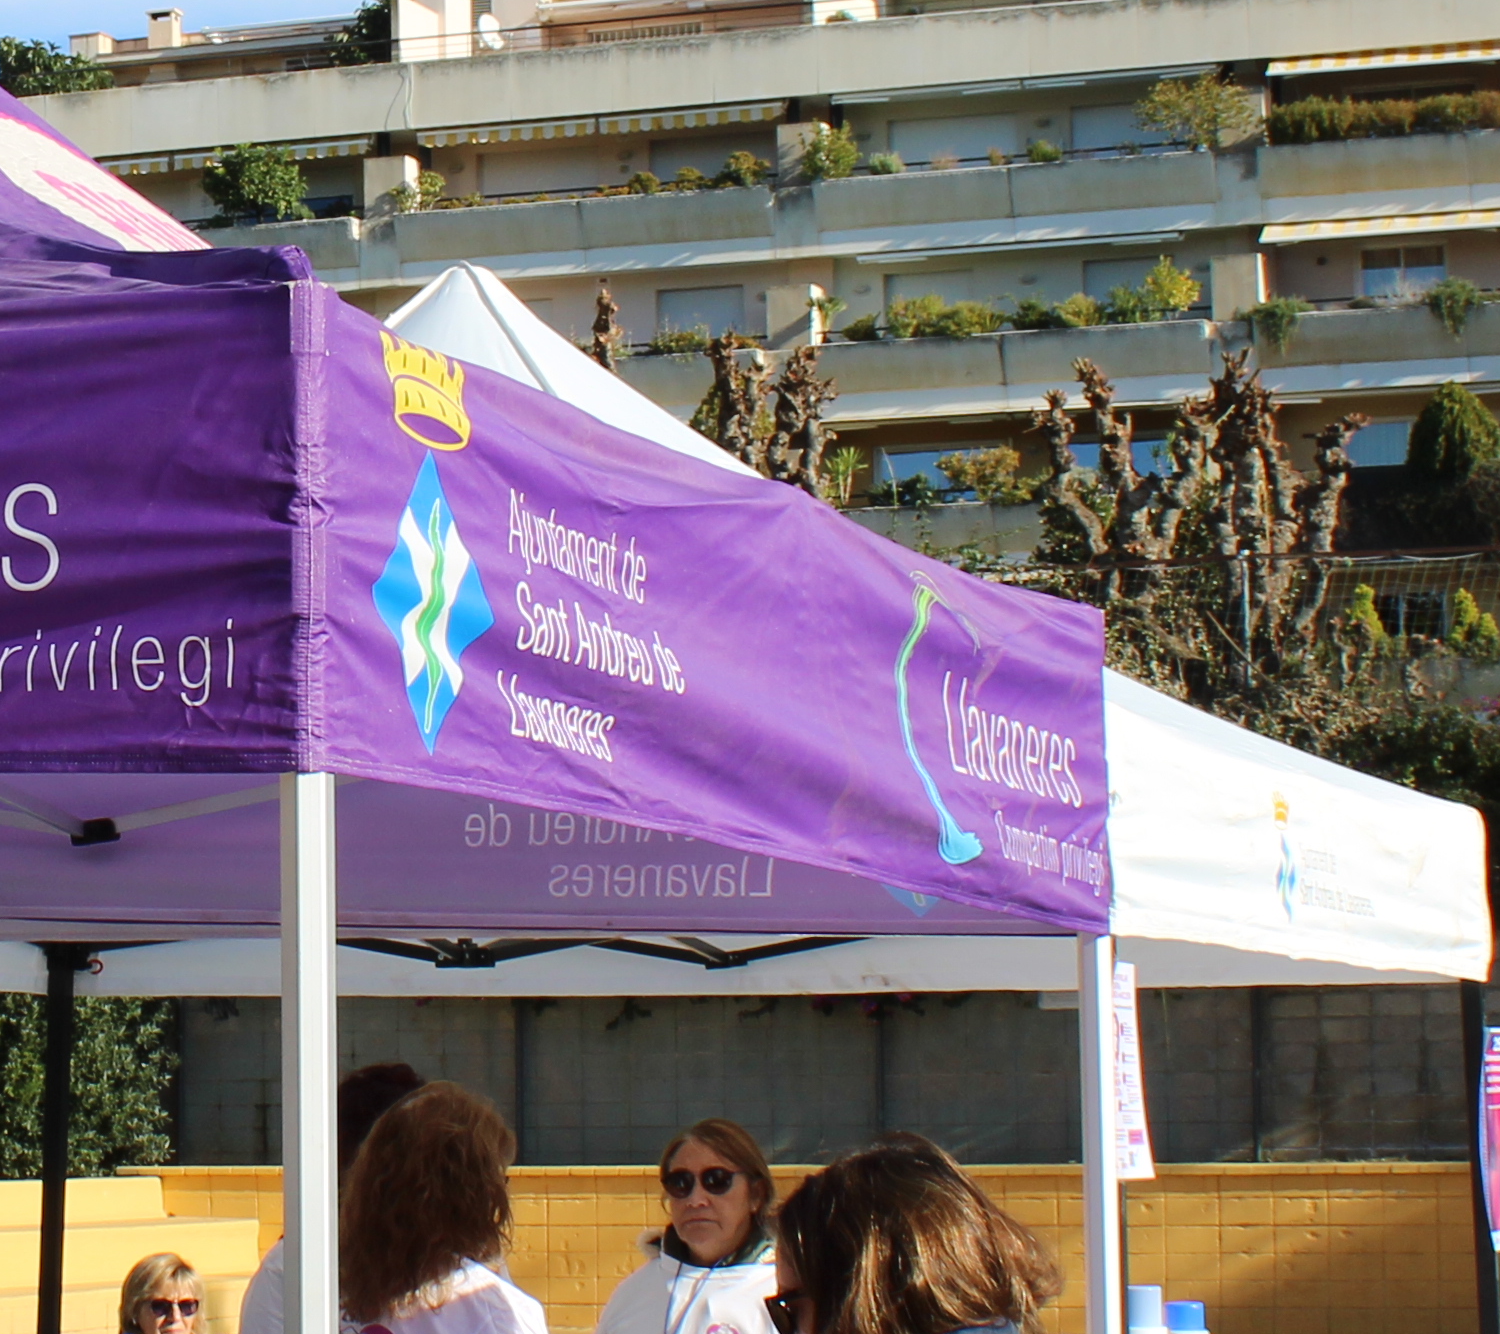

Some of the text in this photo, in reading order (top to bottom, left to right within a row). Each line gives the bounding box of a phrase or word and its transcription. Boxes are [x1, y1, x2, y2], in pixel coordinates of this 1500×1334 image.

[509, 488, 646, 604] Ajuntament de
[516, 581, 685, 695] Sant Andreu de
[497, 669, 616, 763] Llavaneres
[943, 671, 1083, 809] Llavaneres
[995, 810, 1105, 897] Compartim privilegi
